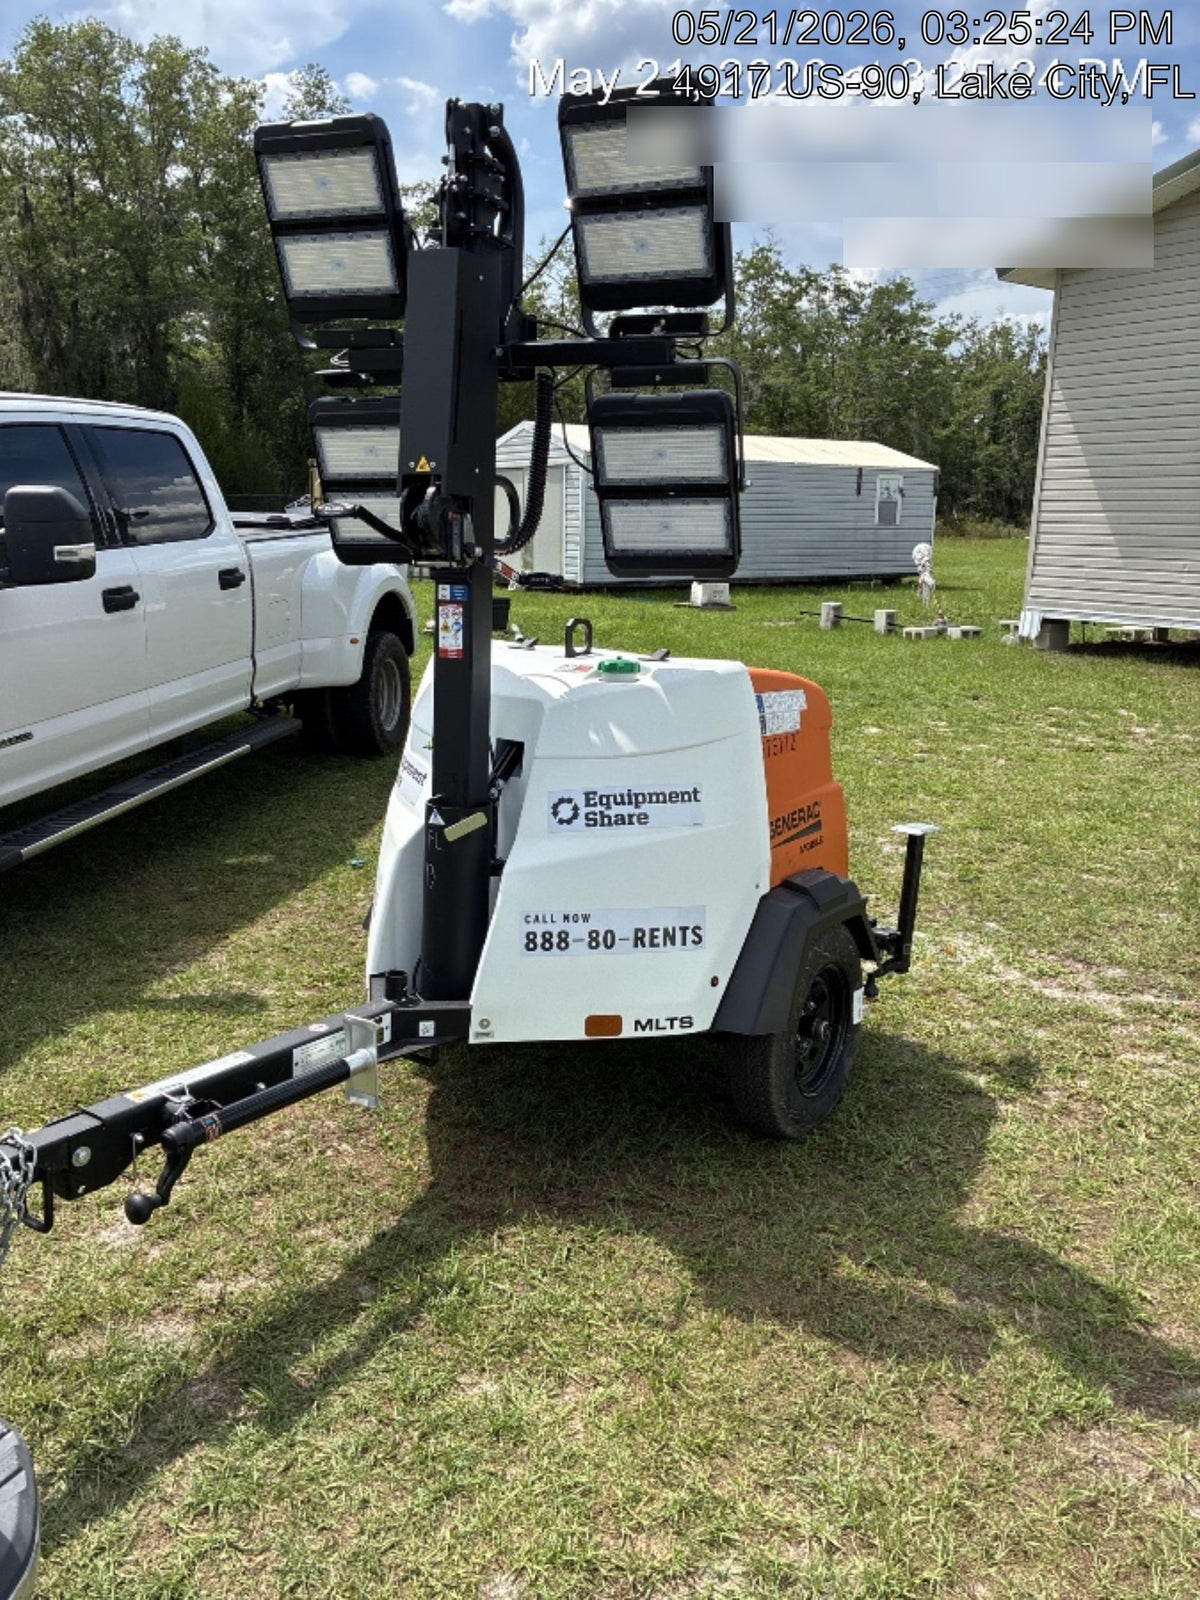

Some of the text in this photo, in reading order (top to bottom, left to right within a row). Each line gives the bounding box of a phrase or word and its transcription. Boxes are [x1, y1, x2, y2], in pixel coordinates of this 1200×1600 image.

[582, 787, 701, 809] Equipment
[584, 810, 650, 828] Share
[524, 912, 592, 924] CALL NOW
[523, 924, 704, 952] 888-80-RENTS
[633, 1016, 695, 1032] MLTS
